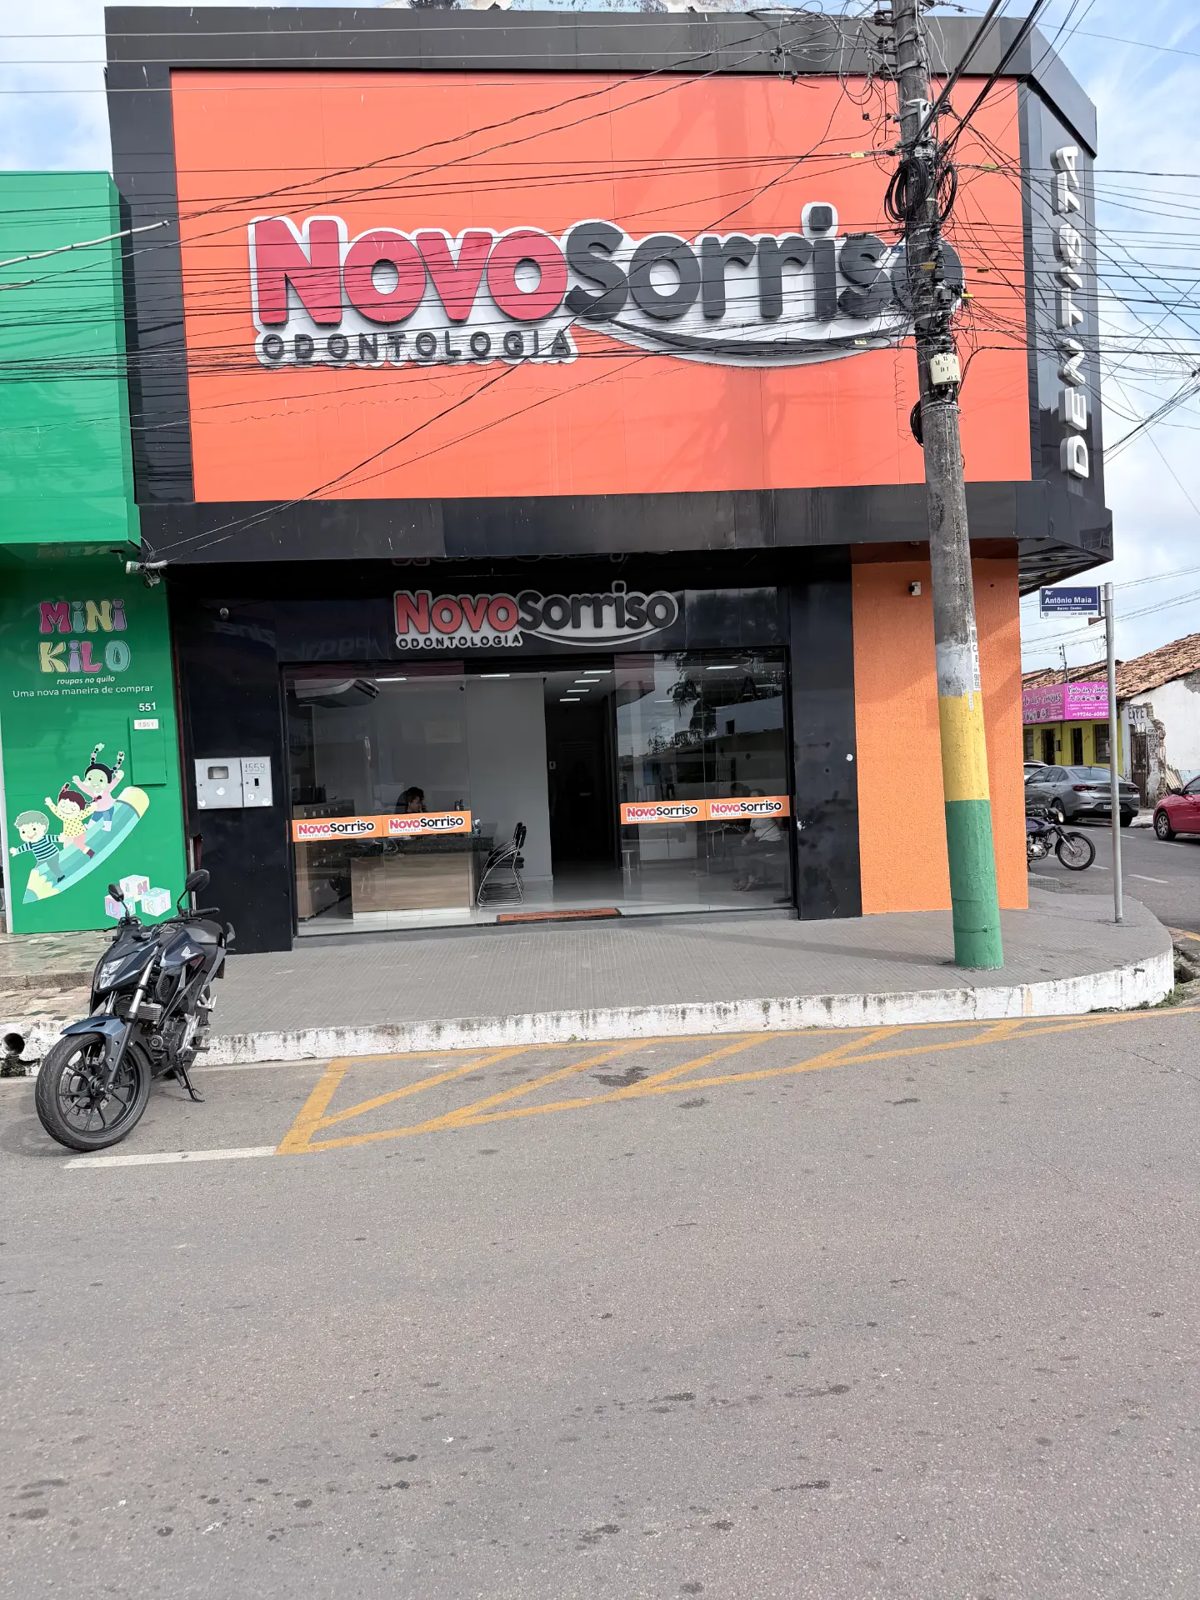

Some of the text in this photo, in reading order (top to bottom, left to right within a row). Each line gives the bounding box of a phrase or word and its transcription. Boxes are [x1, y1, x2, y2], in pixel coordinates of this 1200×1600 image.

[1055, 145, 1090, 480] DENTISTA
[261, 329, 573, 361] ODONTOLOGIA
[1044, 596, 1073, 604] Antônio
[398, 633, 523, 650] ODONTOLOGIA
[56, 677, 83, 686] roupas
[96, 675, 116, 685] quilo
[12, 685, 154, 698] Uma nova maneira de comprar
[138, 701, 157, 713] 551
